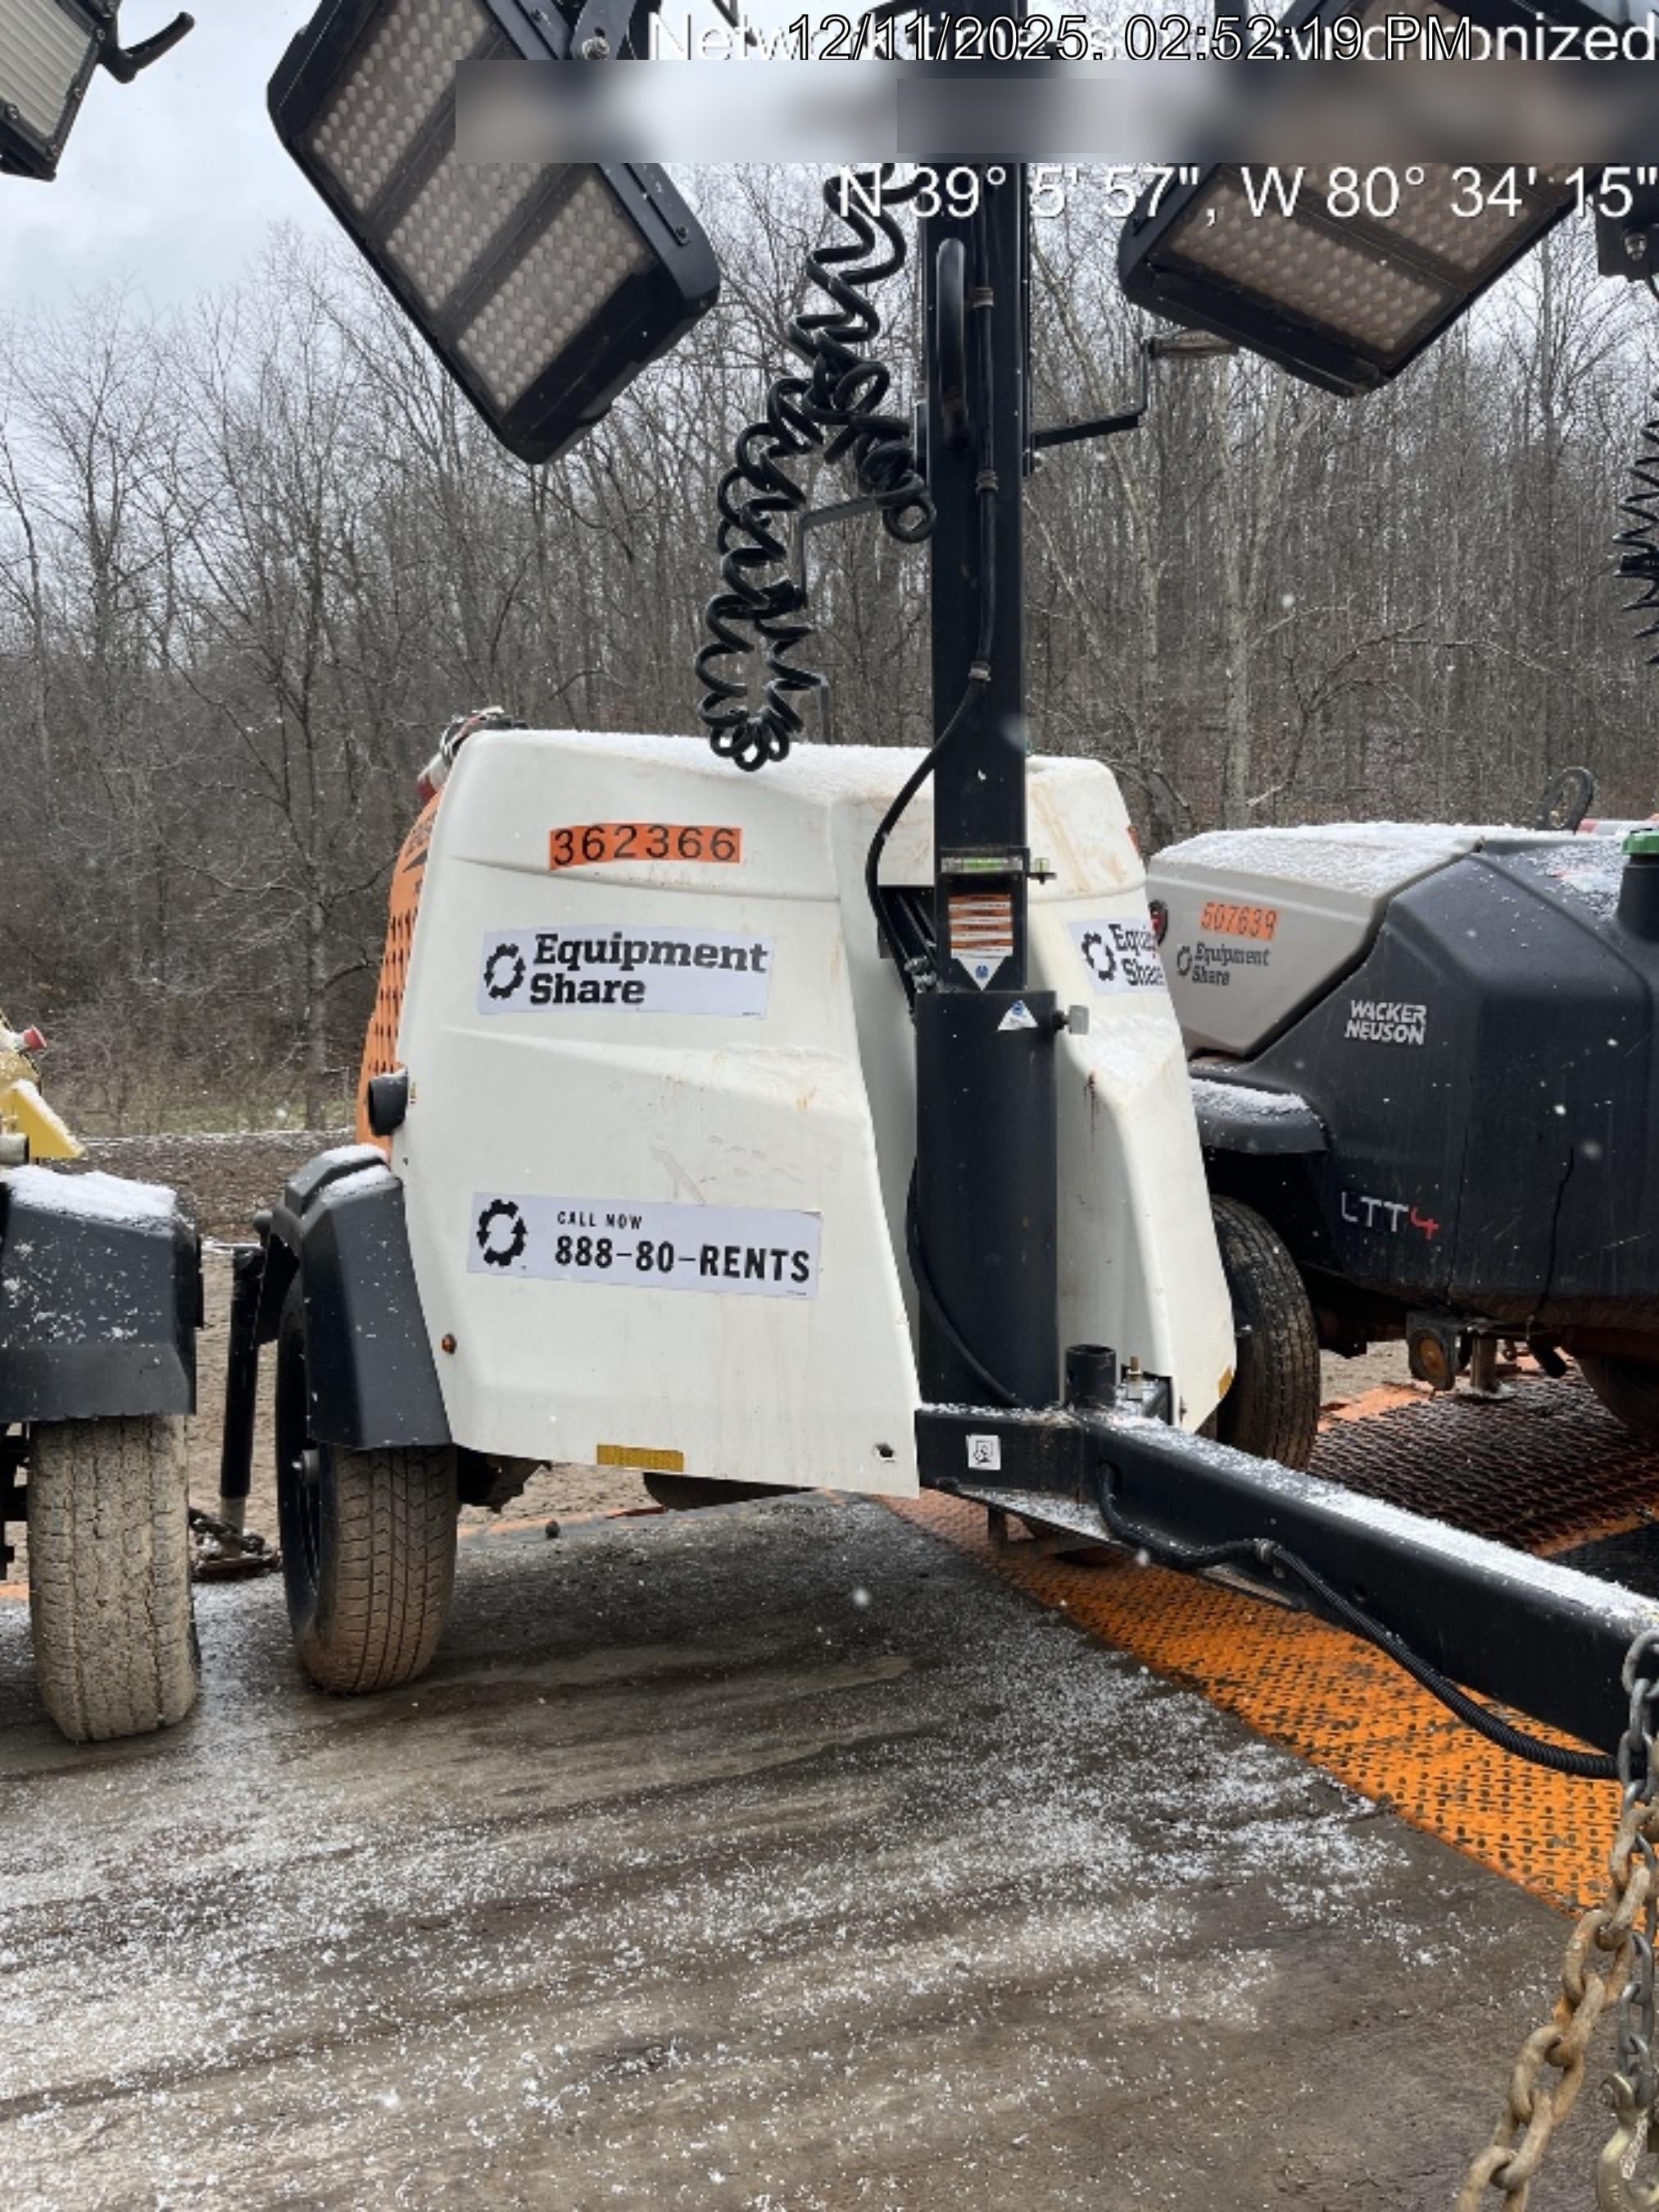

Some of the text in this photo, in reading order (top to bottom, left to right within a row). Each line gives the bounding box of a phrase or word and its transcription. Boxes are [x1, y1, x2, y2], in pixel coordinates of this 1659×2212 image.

[554, 824, 737, 866] 362366
[1201, 902, 1277, 941] 507639
[534, 931, 769, 973] Equipment
[1194, 941, 1271, 967] Equipment
[529, 972, 646, 1005] Share
[1191, 964, 1231, 986] Share
[1350, 999, 1427, 1026] WACKER
[1344, 1019, 1426, 1046] NEUSON
[557, 1210, 643, 1230] CALL NOW
[555, 1234, 811, 1284] 888-80-RENTS
